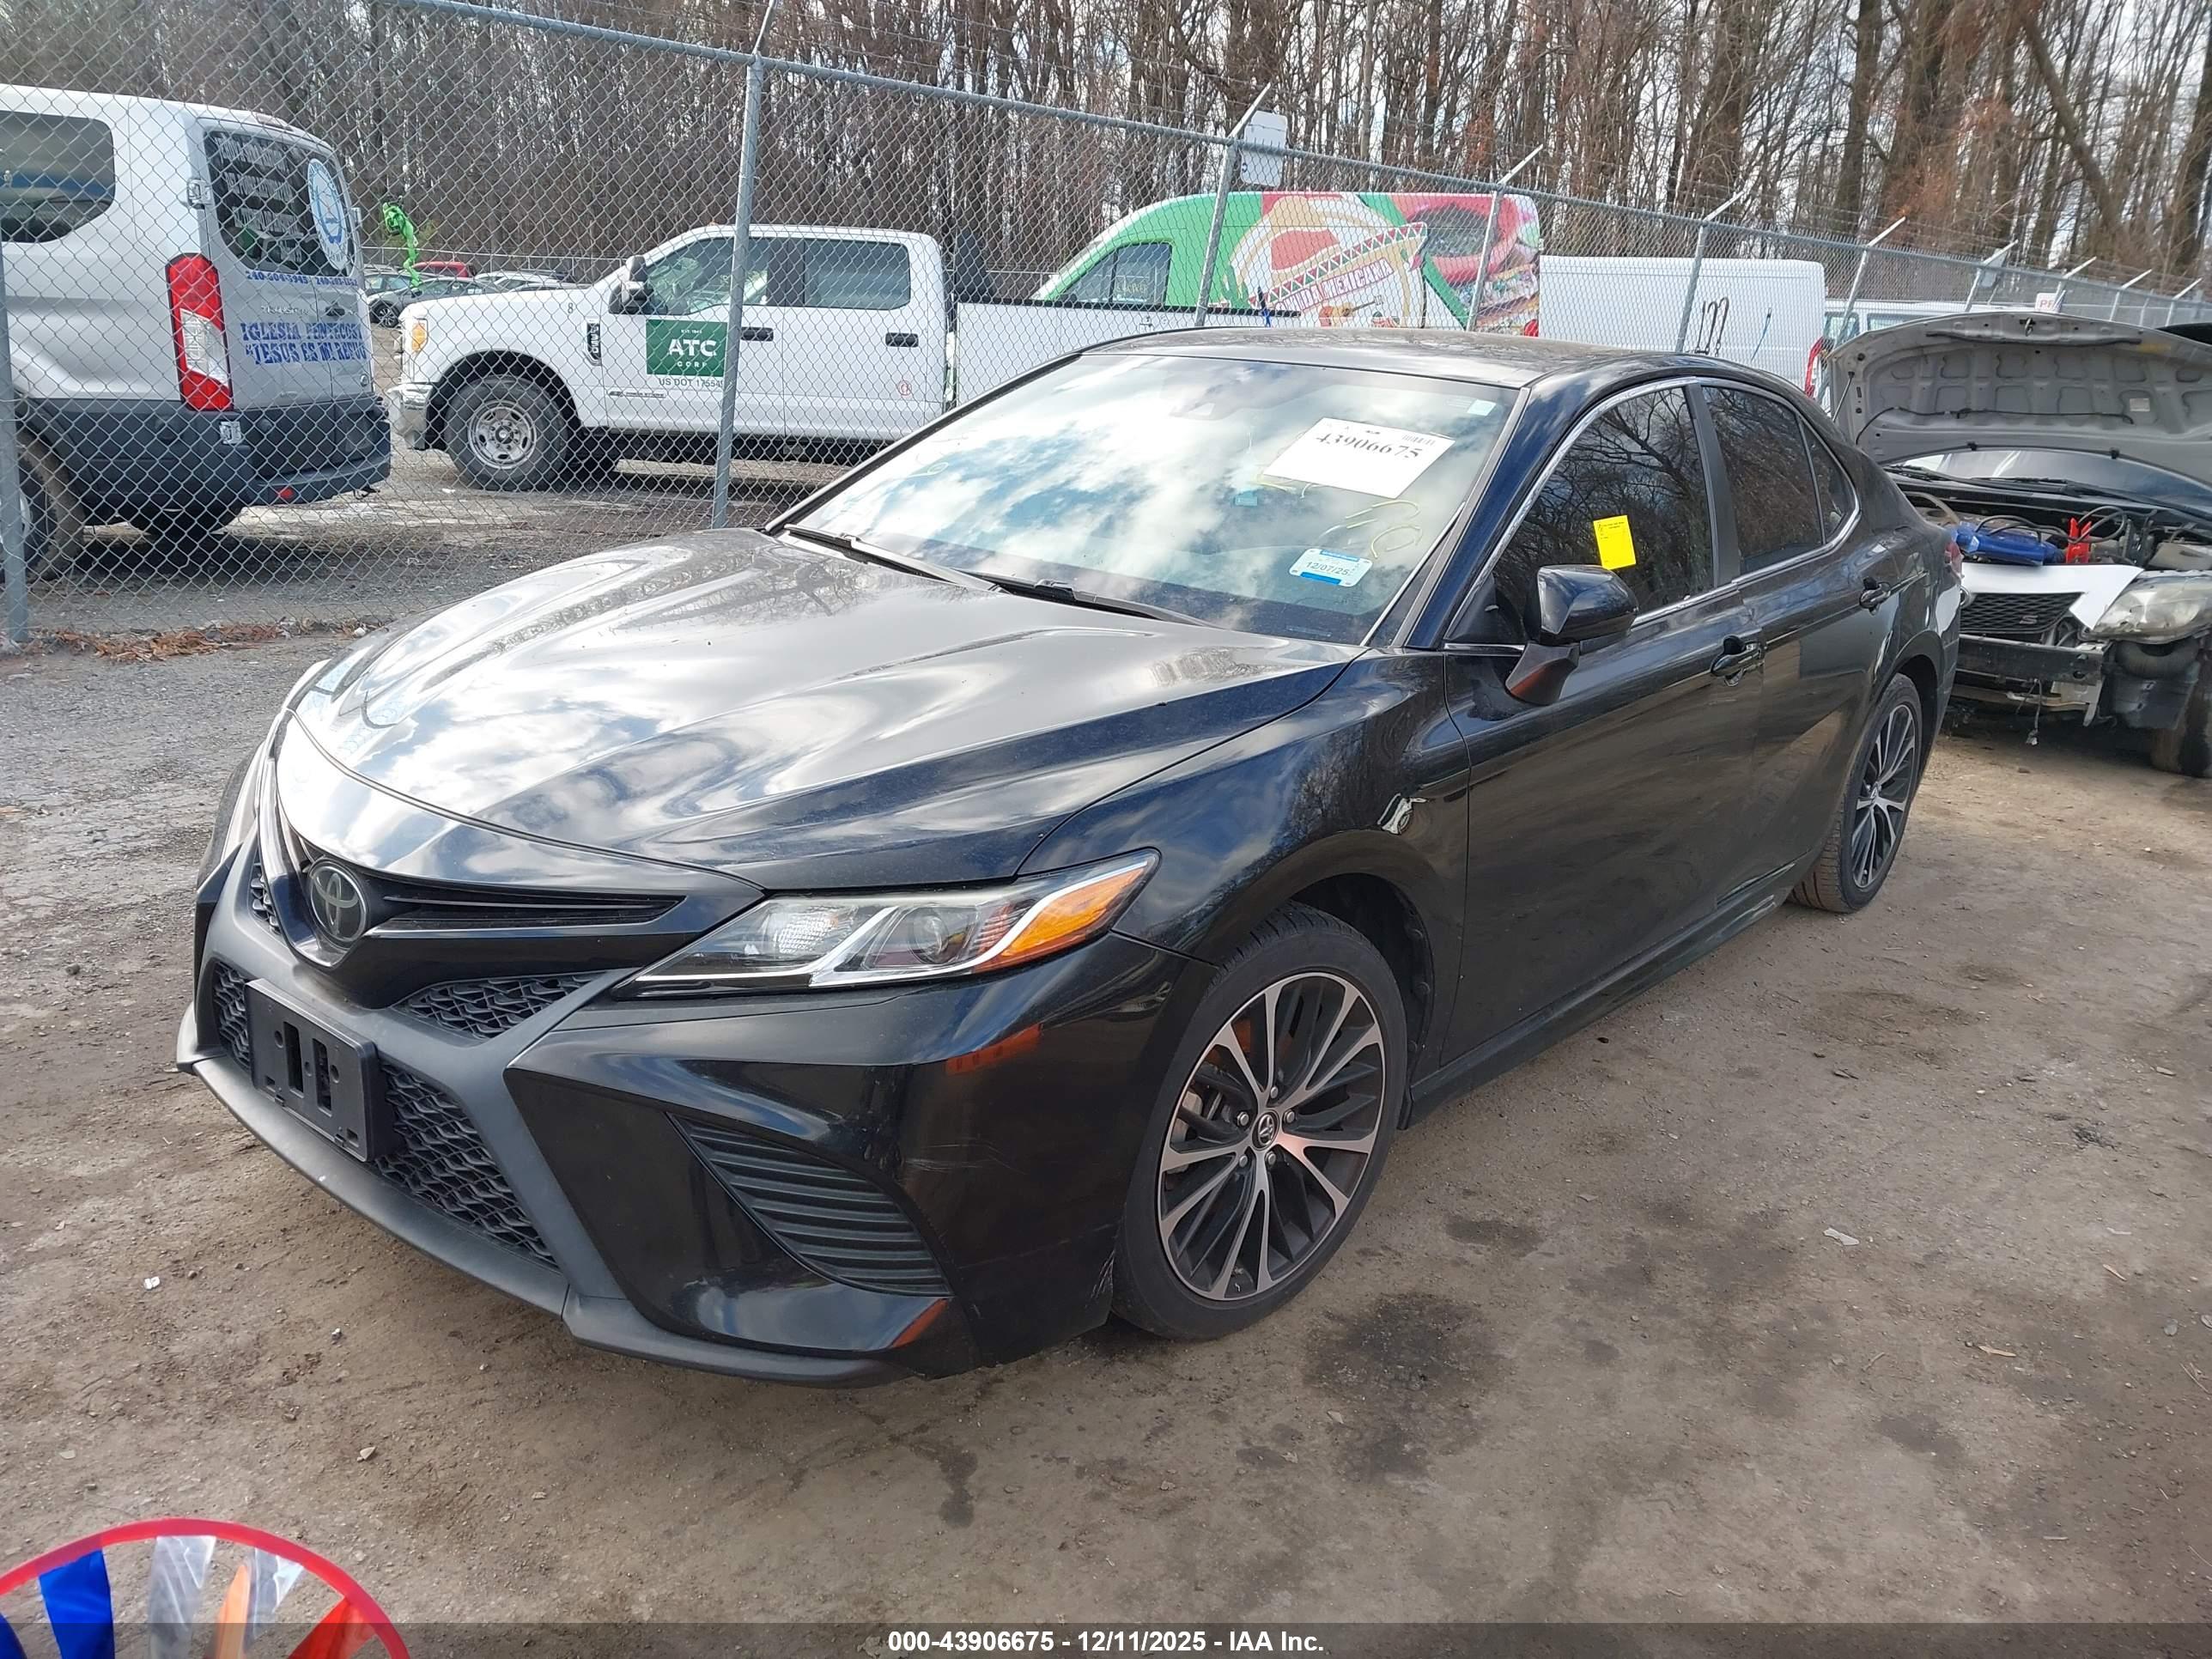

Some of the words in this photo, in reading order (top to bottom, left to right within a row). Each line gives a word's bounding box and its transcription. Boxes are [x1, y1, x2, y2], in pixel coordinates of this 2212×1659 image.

[1322, 258, 1394, 299] MEXICANA
[567, 302, 574, 314] 8
[240, 322, 301, 341] IGLESIA
[301, 343, 319, 362] ES
[668, 338, 717, 357] ATC
[674, 378, 694, 386] DOT
[1316, 433, 1423, 459] 43906675
[1306, 561, 1350, 575] 12/07/25
